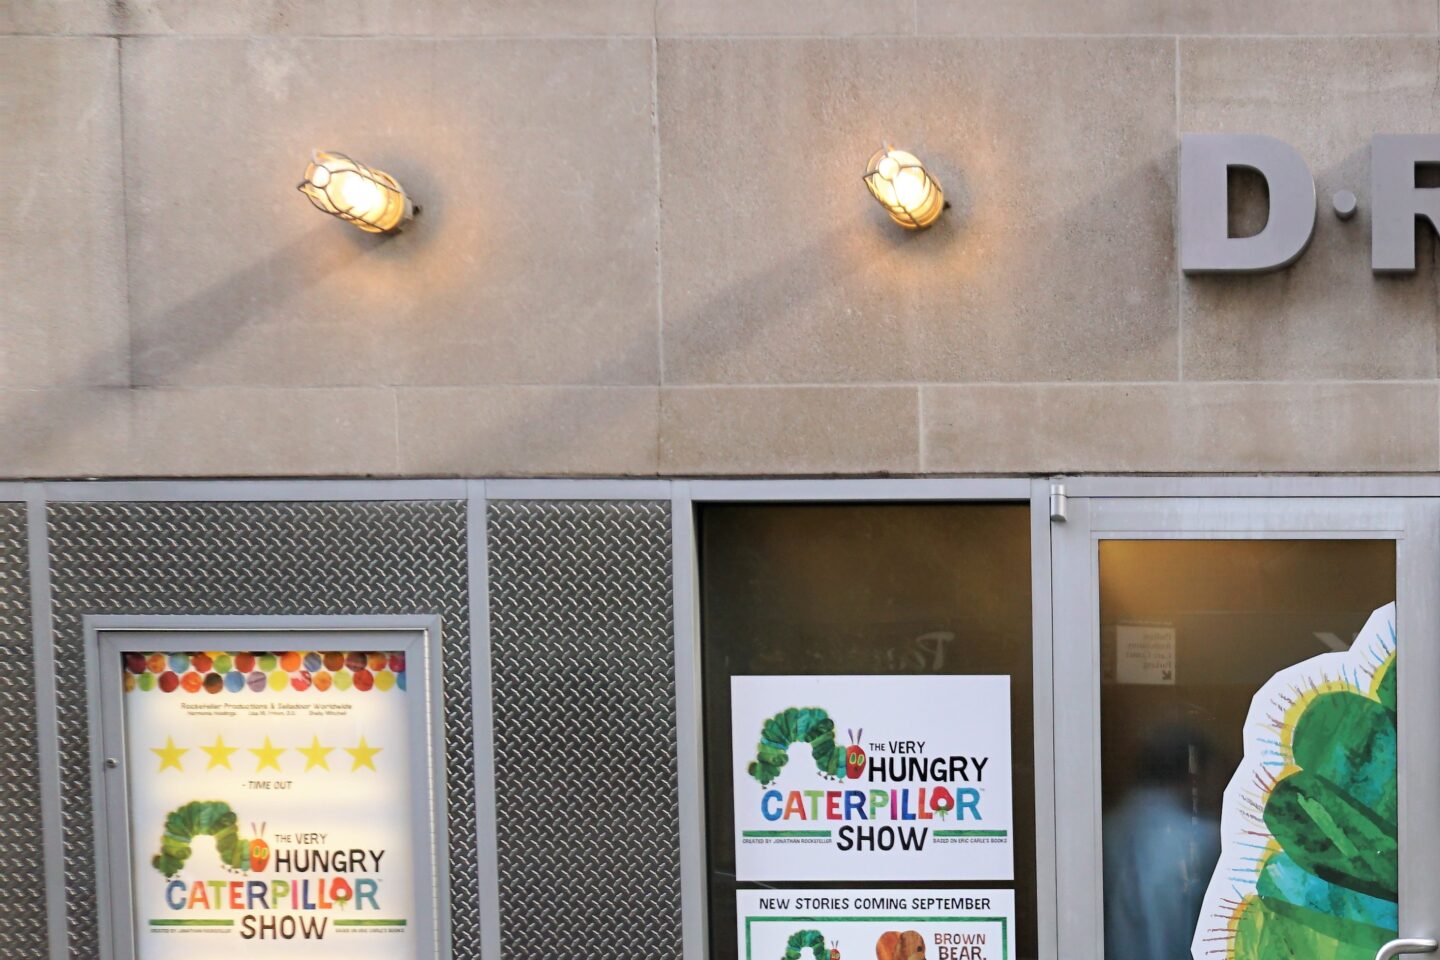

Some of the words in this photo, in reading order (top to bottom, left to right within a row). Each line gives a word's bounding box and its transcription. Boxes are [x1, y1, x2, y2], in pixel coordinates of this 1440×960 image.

[869, 743, 886, 752] THE
[888, 741, 926, 754] VERY
[868, 756, 989, 783] HUNGRY
[274, 780, 292, 790] OUT
[275, 834, 291, 843] THE
[295, 833, 327, 845] VERY
[836, 825, 929, 851] SHOW
[274, 849, 384, 873] HUNGRY
[759, 898, 790, 910] NEW
[795, 898, 850, 910] STORIES
[854, 898, 907, 910] COMING
[912, 898, 991, 910] SEPTEMBER
[239, 915, 328, 940] SHOW
[934, 933, 986, 945] BROWN
